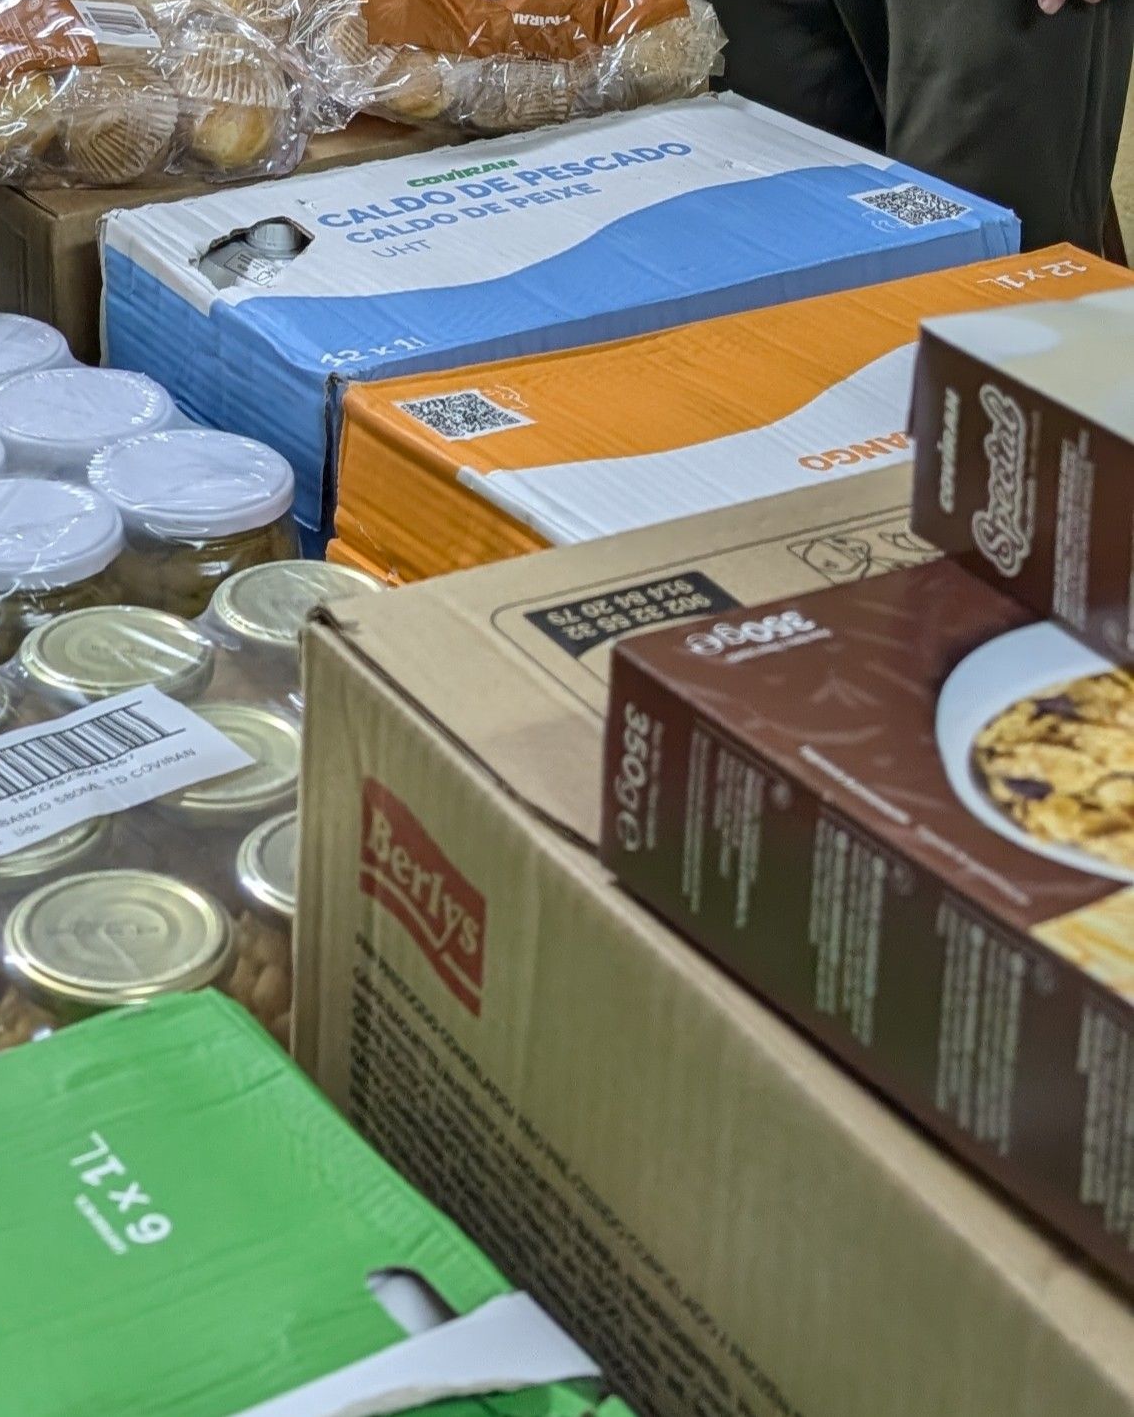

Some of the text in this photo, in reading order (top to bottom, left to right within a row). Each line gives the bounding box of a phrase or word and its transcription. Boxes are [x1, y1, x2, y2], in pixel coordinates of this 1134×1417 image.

[317, 141, 692, 228] CALDO DE PESCADO
[406, 158, 520, 188] COVIRAN
[346, 181, 602, 245] CALDO DE PEIXE
[371, 238, 432, 259] UHT
[1041, 259, 1088, 279] 12
[797, 431, 911, 472] ANGO
[936, 386, 960, 514] COVIRAN
[972, 383, 1029, 578] Special
[130, 747, 197, 779] COVIRAN
[368, 806, 480, 957] Berlys
[69, 1129, 127, 1187] 1L
[106, 1180, 152, 1214] x
[125, 1212, 172, 1244] 6
